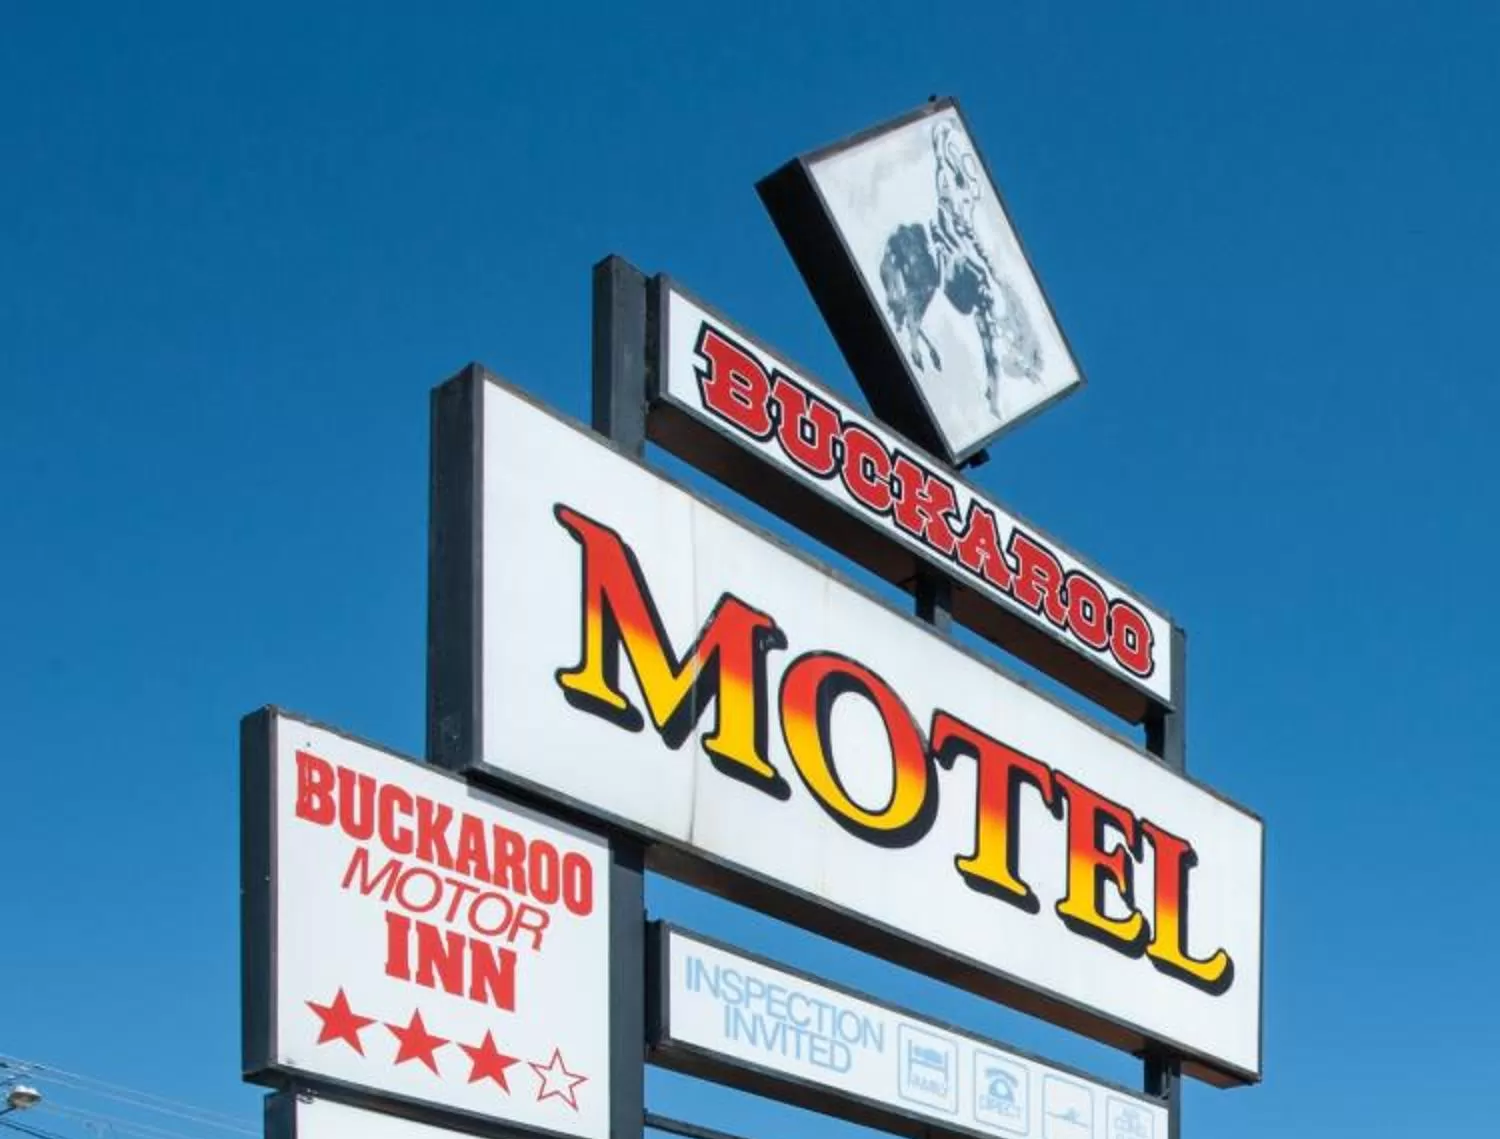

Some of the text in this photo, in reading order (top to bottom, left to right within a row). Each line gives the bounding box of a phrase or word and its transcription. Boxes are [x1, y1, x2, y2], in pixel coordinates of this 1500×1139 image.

[693, 322, 1155, 678] BUCKAROO
[553, 502, 1234, 997] MOTEL
[295, 749, 593, 916] BUCKAROO
[341, 847, 551, 951] MOTOR
[385, 910, 517, 1012] INN
[685, 955, 884, 1054] INSPECTION
[724, 1004, 852, 1074] INVITED
